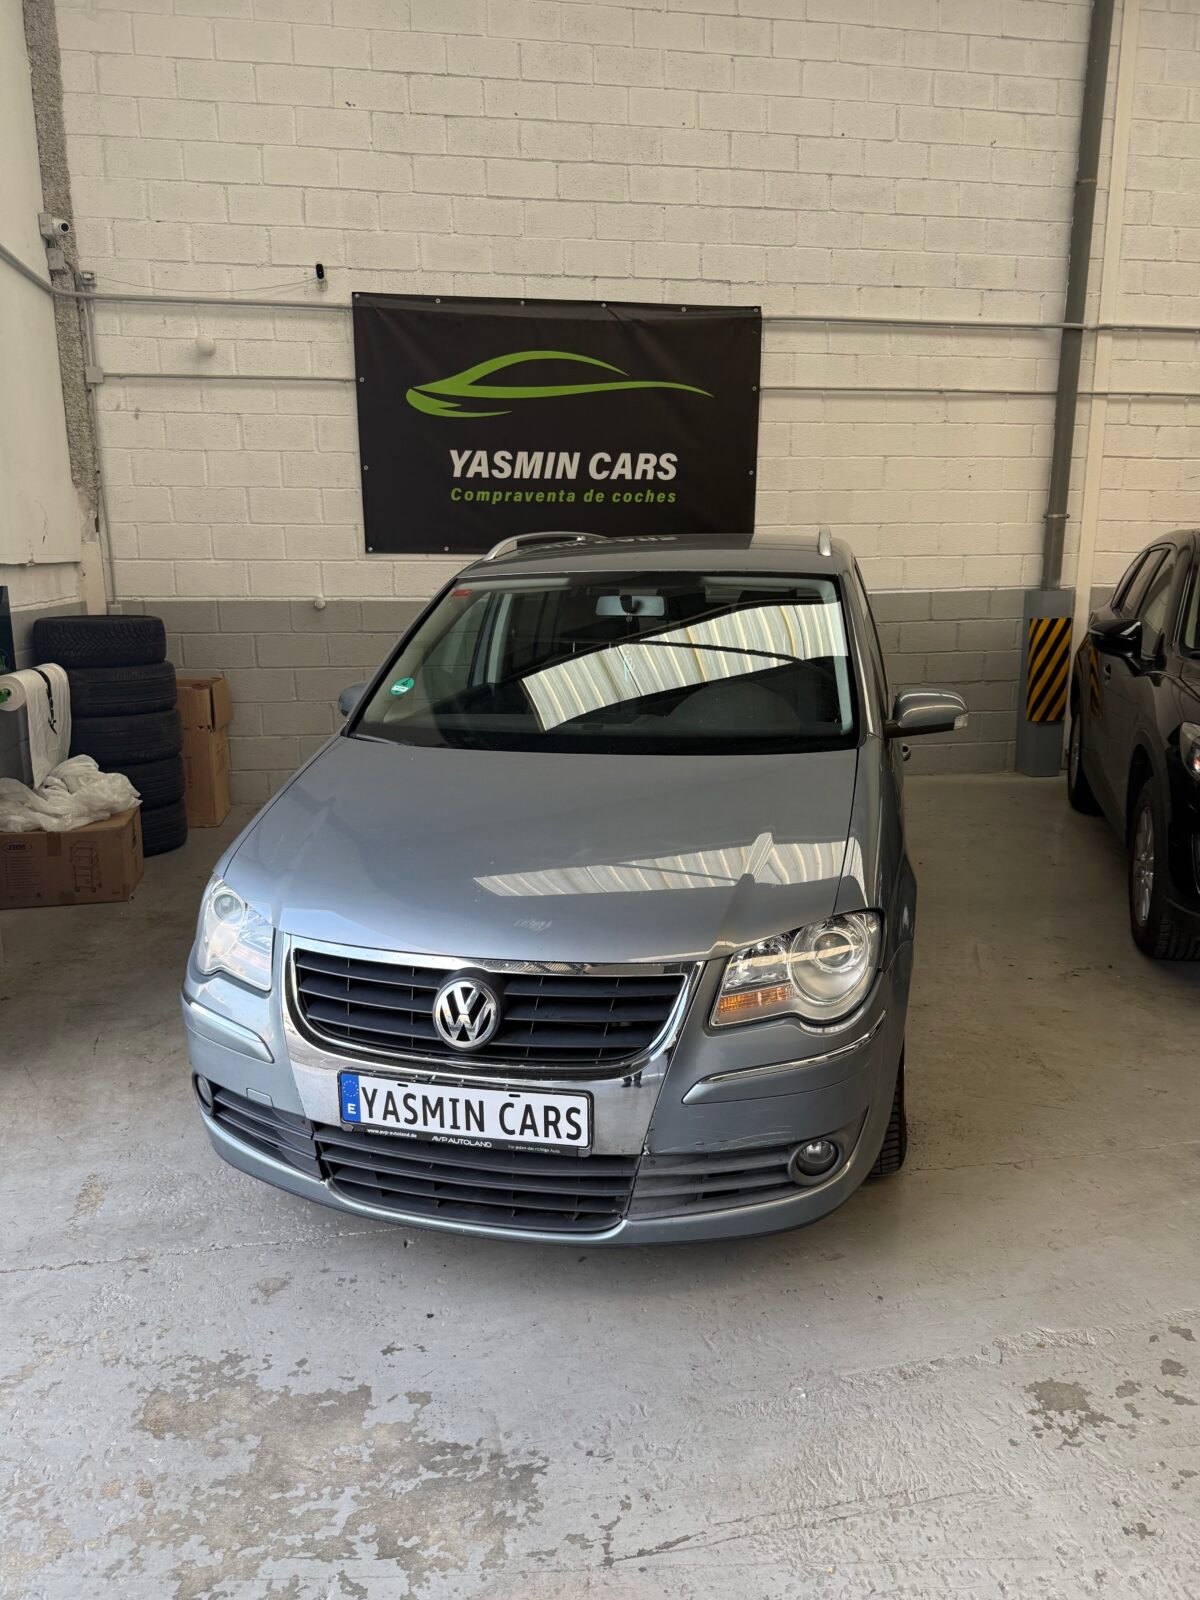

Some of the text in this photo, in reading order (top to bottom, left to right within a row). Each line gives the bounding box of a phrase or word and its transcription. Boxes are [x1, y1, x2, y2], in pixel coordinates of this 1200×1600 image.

[449, 449, 679, 481] YASMIN CARS
[450, 488, 677, 505] Compraventa de coches
[437, 981, 495, 1047] VW
[347, 1103, 356, 1114] E
[361, 1086, 582, 1140] YASMIN CARS
[448, 1138, 493, 1148] AUTOLAND
